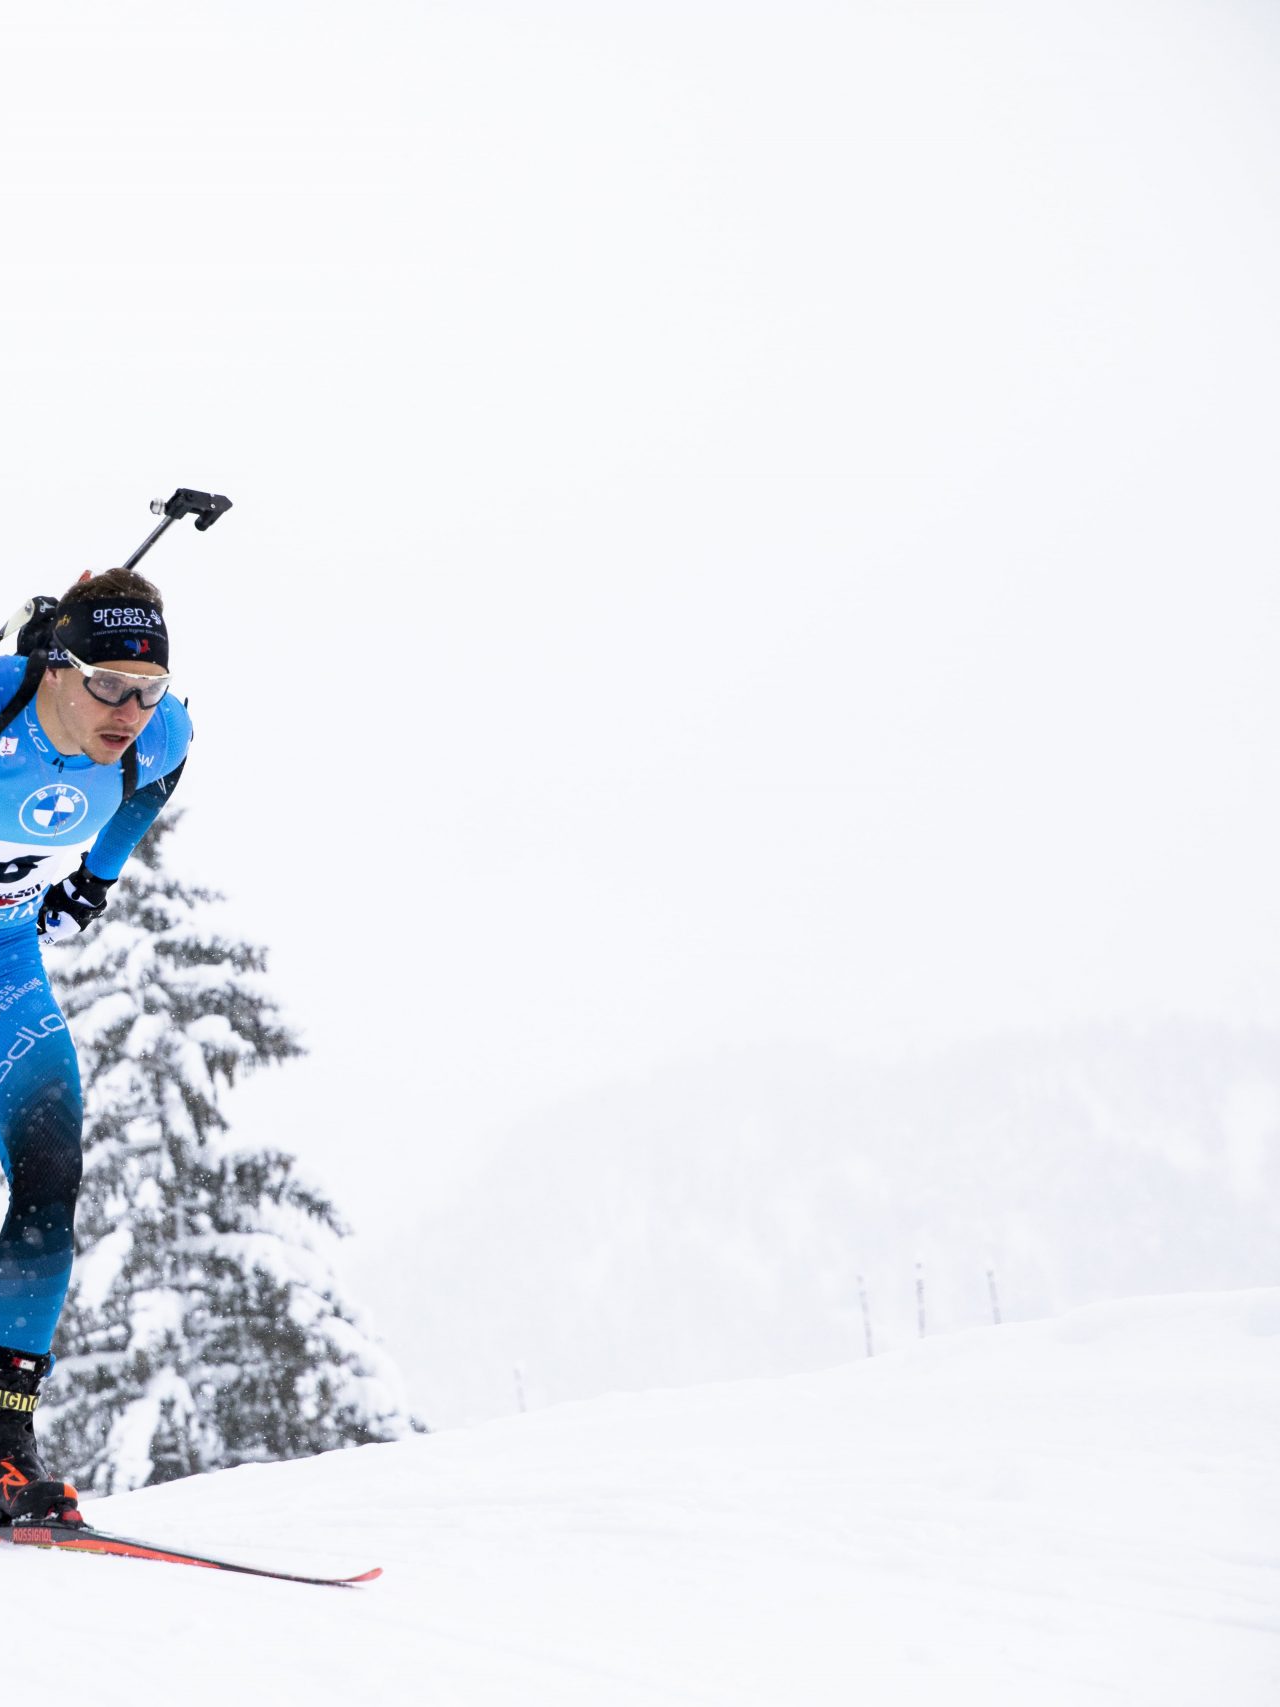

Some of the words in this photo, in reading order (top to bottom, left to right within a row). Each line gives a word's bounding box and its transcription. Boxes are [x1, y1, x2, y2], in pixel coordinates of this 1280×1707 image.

[93, 607, 146, 623] green
[104, 616, 153, 628] weez
[35, 787, 82, 804] BMW
[13, 1526, 52, 1542] ROSSIGNOL
